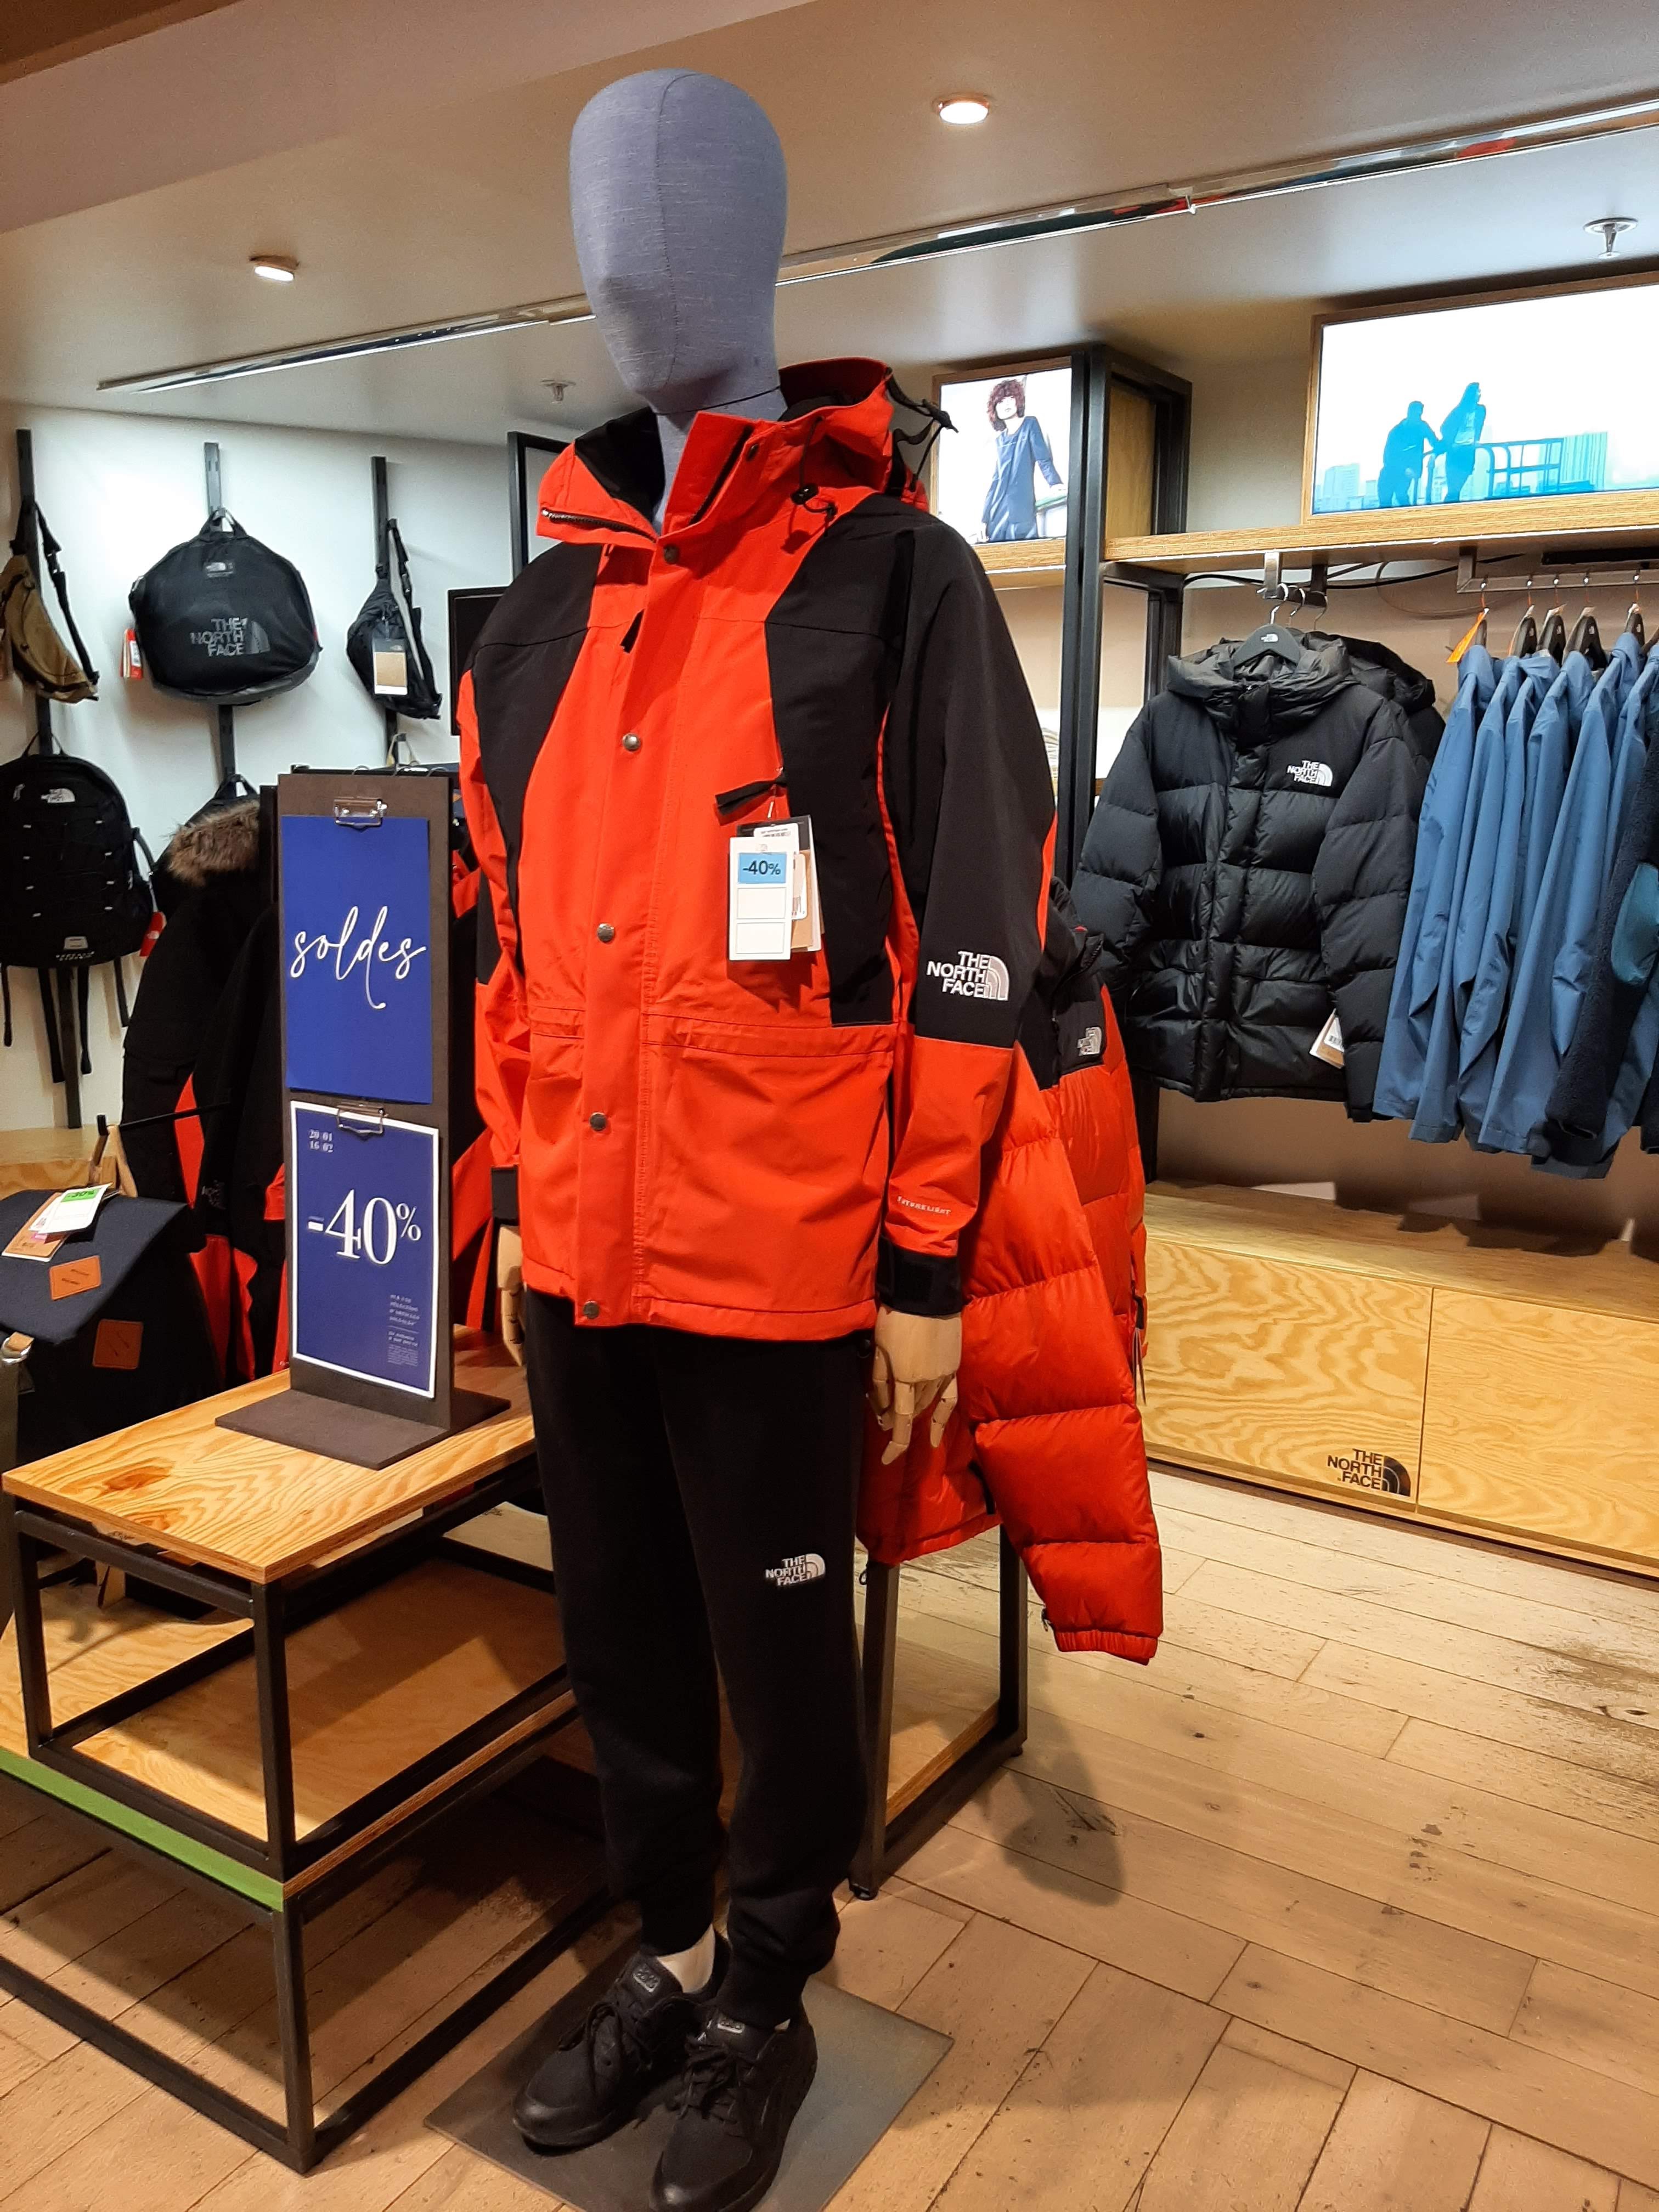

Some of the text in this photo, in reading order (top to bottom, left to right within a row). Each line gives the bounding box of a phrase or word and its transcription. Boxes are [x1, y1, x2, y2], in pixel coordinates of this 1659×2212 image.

[211, 618, 242, 631] THE
[190, 630, 244, 645] NORTH
[207, 642, 244, 657] FACE
[1286, 765, 1317, 777] NORTH
[1302, 760, 1319, 770] THE
[1294, 773, 1317, 784] FACE
[742, 860, 781, 875] -40%
[290, 906, 427, 1009] soldes
[958, 950, 991, 969] THE
[926, 961, 987, 984] NORTH
[941, 978, 986, 998] FACE
[310, 1141, 334, 1153] 16 02
[308, 1189, 421, 1265] -40%
[1352, 1448, 1383, 1466] THE
[1327, 1455, 1381, 1478] NORTH
[1342, 1471, 1381, 1490] FACE
[782, 1555, 805, 1567] THE
[765, 1564, 806, 1578] NORTH
[777, 1573, 807, 1586] FACE
